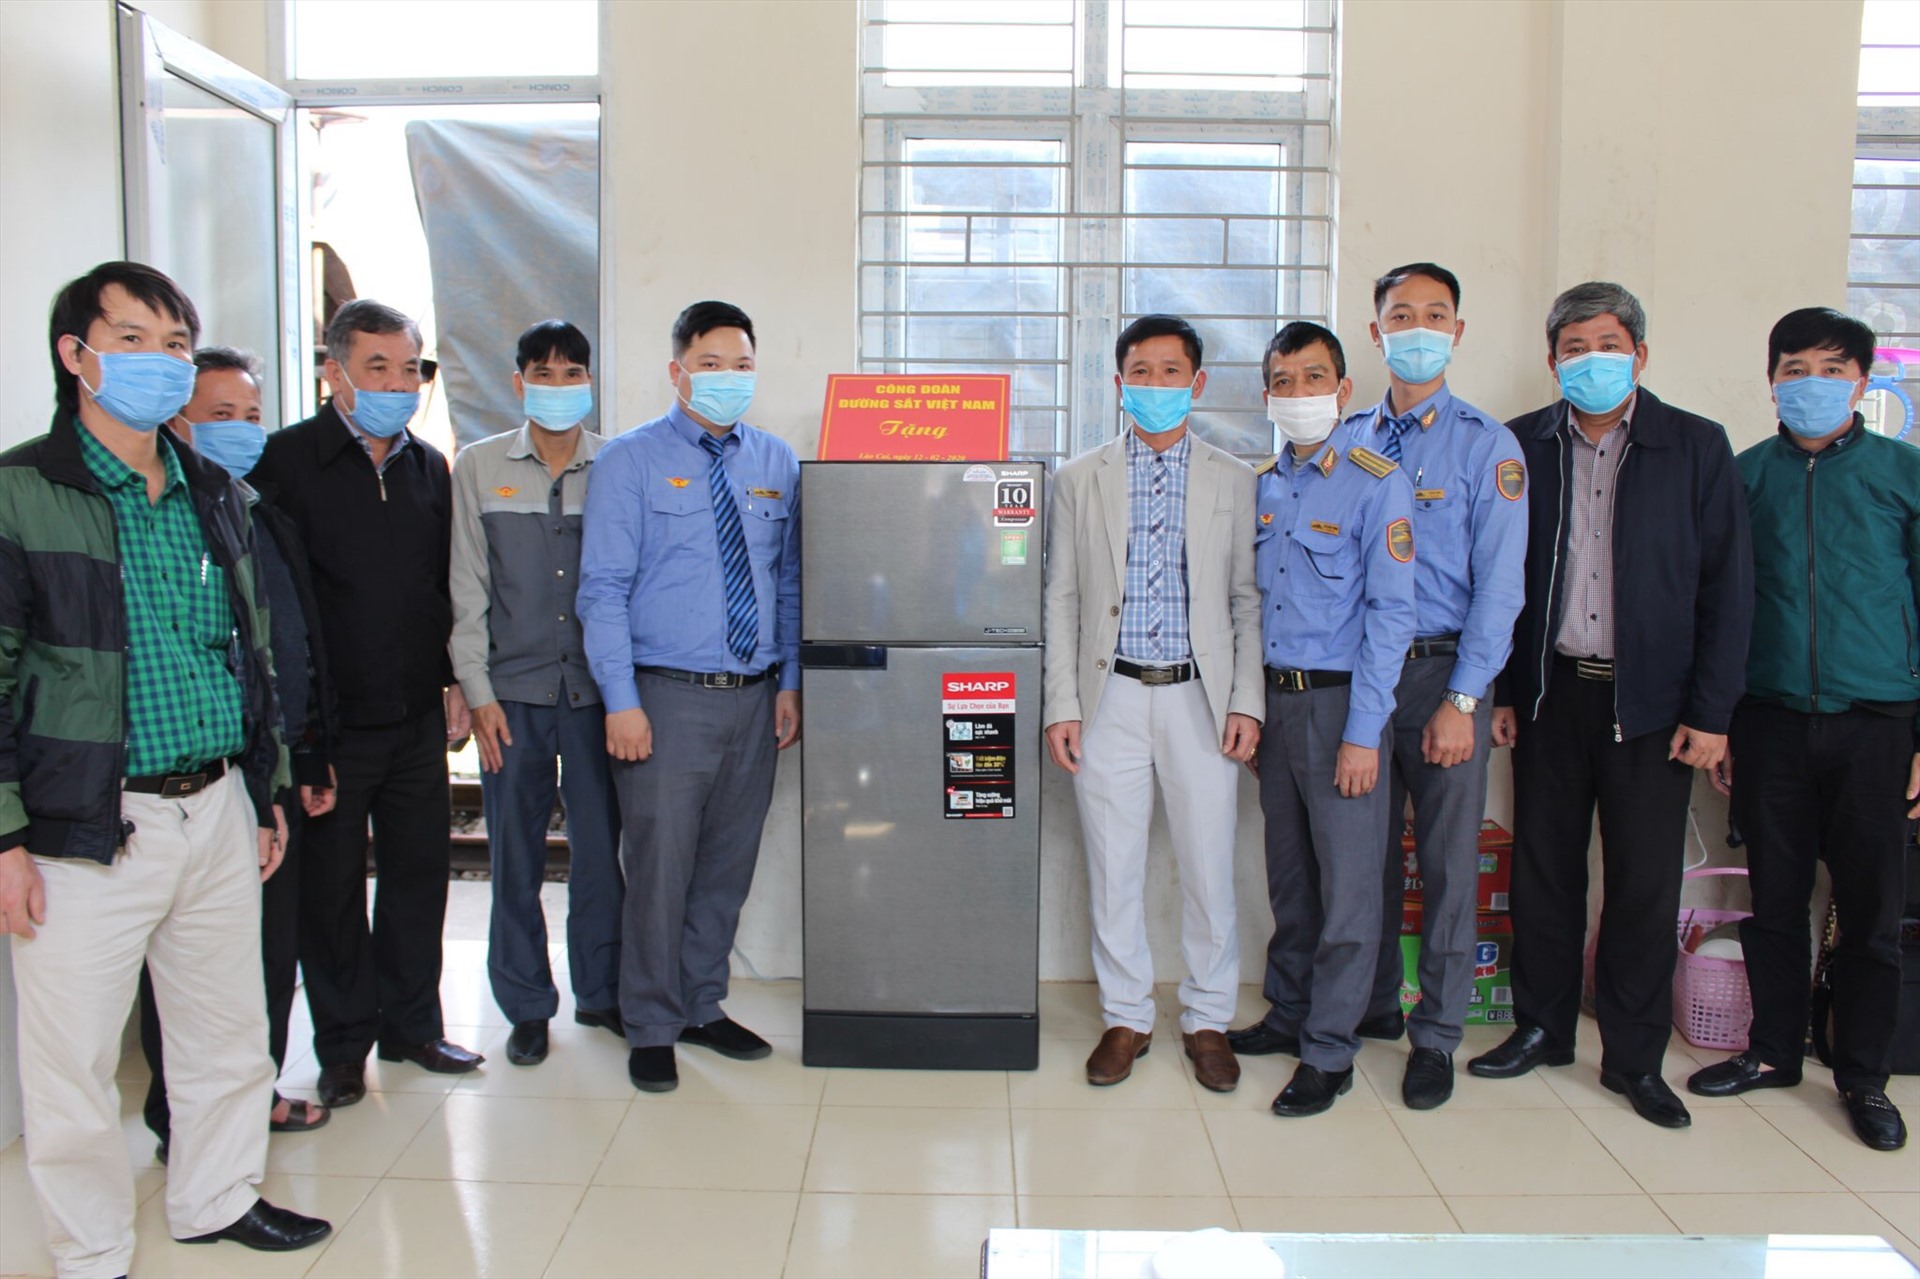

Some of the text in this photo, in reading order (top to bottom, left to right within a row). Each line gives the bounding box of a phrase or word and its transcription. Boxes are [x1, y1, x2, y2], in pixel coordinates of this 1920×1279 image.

[876, 383, 960, 394] CÔNG ĐOÀN
[839, 397, 995, 411] ĐƯỜNG SẮT VIỆT NAM
[880, 420, 948, 440] Tặng
[1001, 487, 1028, 504] 10
[947, 681, 1009, 692] SHARP
